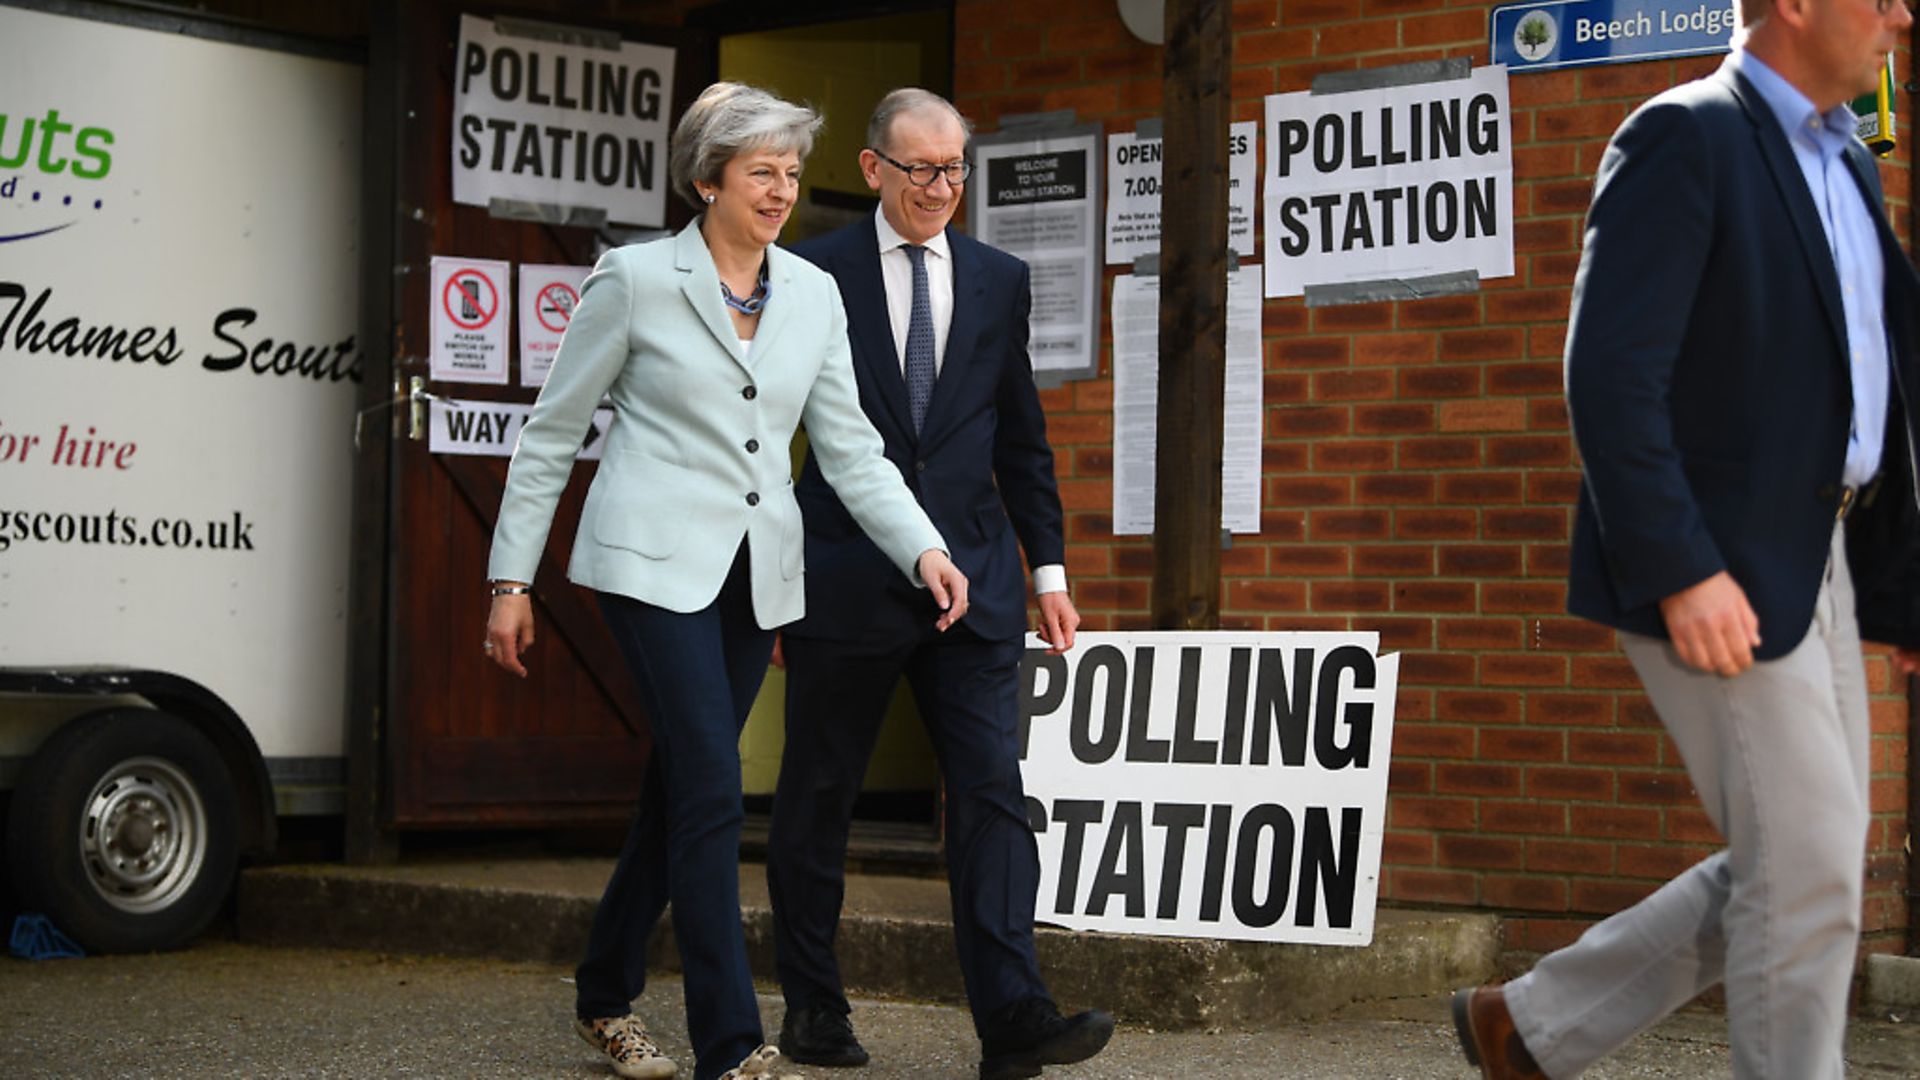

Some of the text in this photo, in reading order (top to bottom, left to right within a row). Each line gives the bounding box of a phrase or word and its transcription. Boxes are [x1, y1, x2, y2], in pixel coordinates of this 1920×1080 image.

[1576, 6, 1735, 42] Beech Lodge
[461, 42, 661, 121] POLLING
[460, 114, 654, 191] STATION
[1015, 158, 1058, 171] WELCOME
[1278, 92, 1499, 178] POLLING
[998, 185, 1076, 200] POLLING STATION
[1018, 175, 1030, 184] TO
[1280, 177, 1496, 257] STATION
[0, 282, 184, 366] Thames
[0, 424, 137, 470] or hire
[446, 410, 511, 444] WAY
[1018, 644, 1377, 771] POLLING
